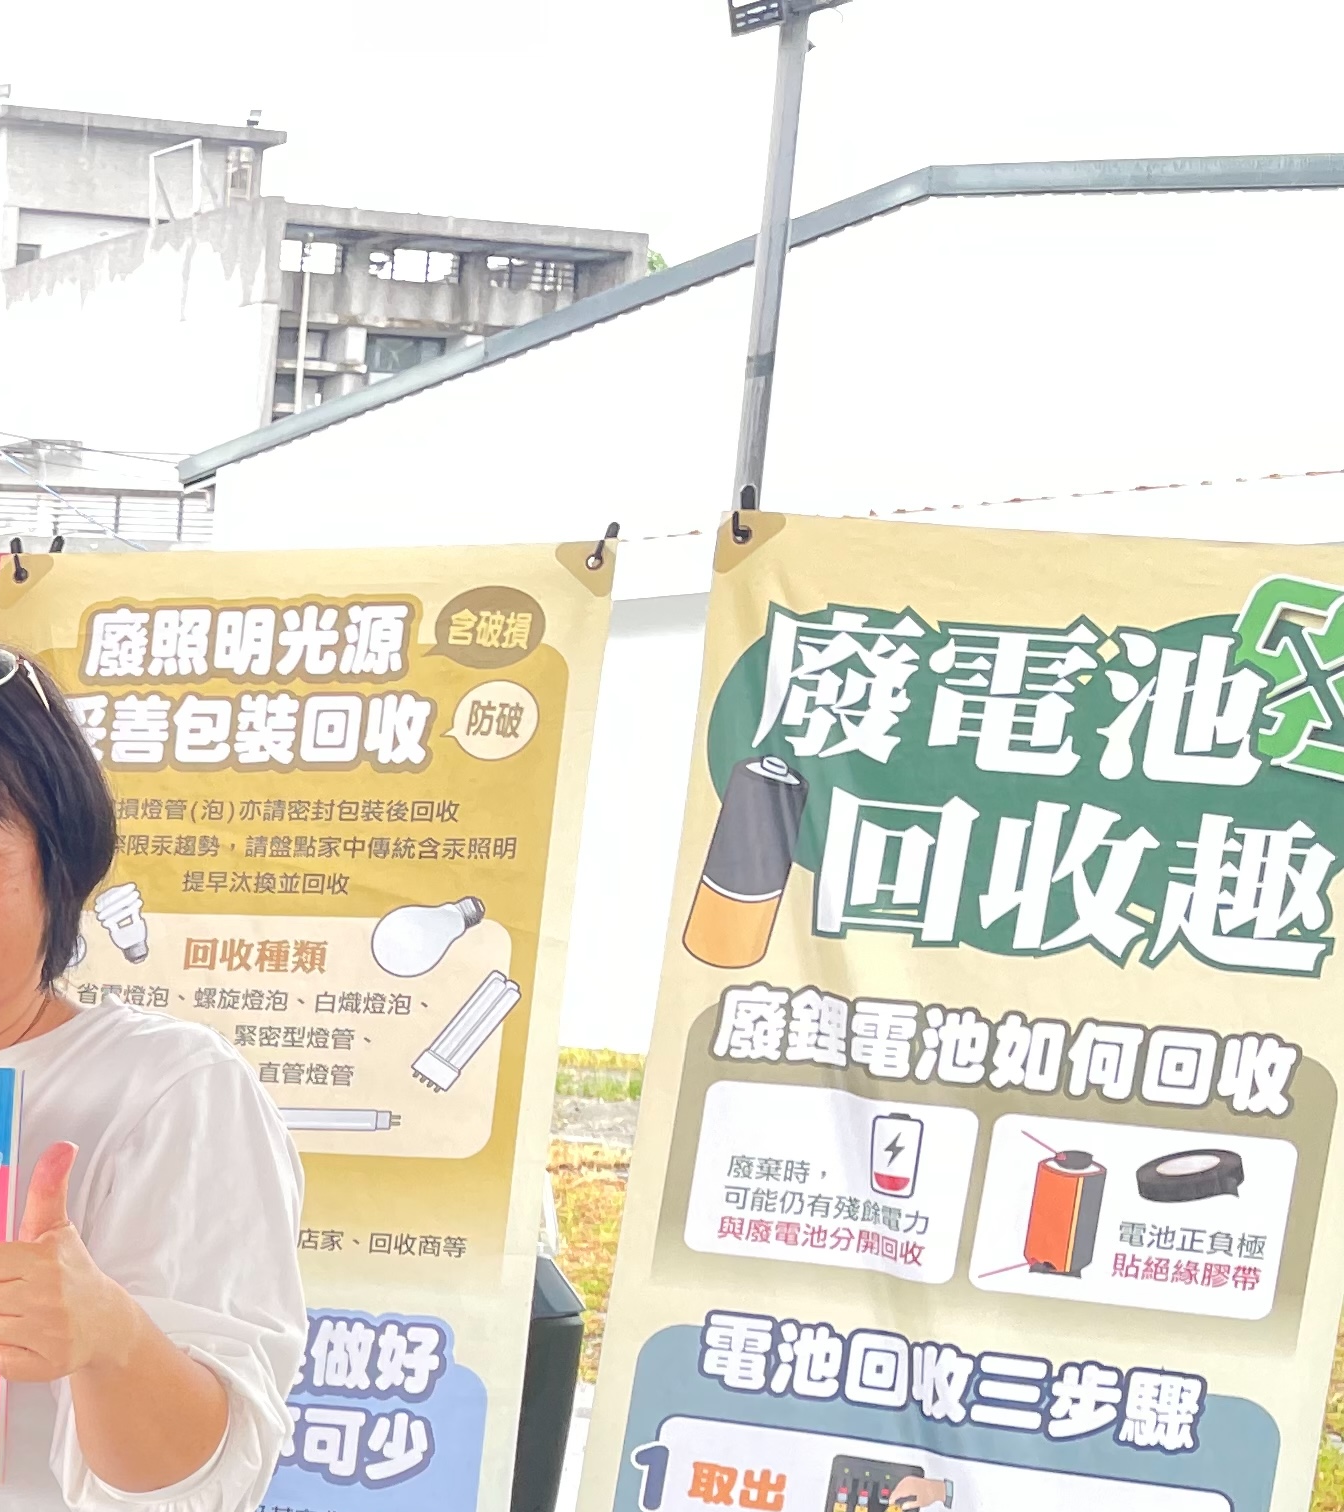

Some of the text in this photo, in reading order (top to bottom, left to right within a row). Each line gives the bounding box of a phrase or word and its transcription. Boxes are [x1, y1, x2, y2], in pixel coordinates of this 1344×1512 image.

[85, 605, 408, 678] 廢照明光源
[447, 610, 535, 653] 含破損
[466, 702, 522, 739] 防破
[752, 611, 1266, 785] 廢電池
[113, 799, 460, 825] 損燈管(泡)亦請密封包裝後回收
[182, 871, 350, 895] 提早汰換並回收
[816, 786, 1335, 971] 回收趣
[184, 937, 328, 974] 回收種類
[259, 1062, 355, 1086] 直管燈管
[714, 986, 1299, 1113] 廢鋰電池如何回收
[724, 1186, 930, 1235] 可能仍有殘餘電力
[718, 1216, 924, 1266] 與廢電池分開回收
[1119, 1221, 1266, 1259] 電池正負極
[1112, 1254, 1262, 1291] 貼絕緣膠帶
[291, 1319, 441, 1394] 做好
[706, 1315, 1203, 1450] 電池回收三步驟
[633, 1446, 669, 1510] 1
[688, 1461, 786, 1512] 取出
